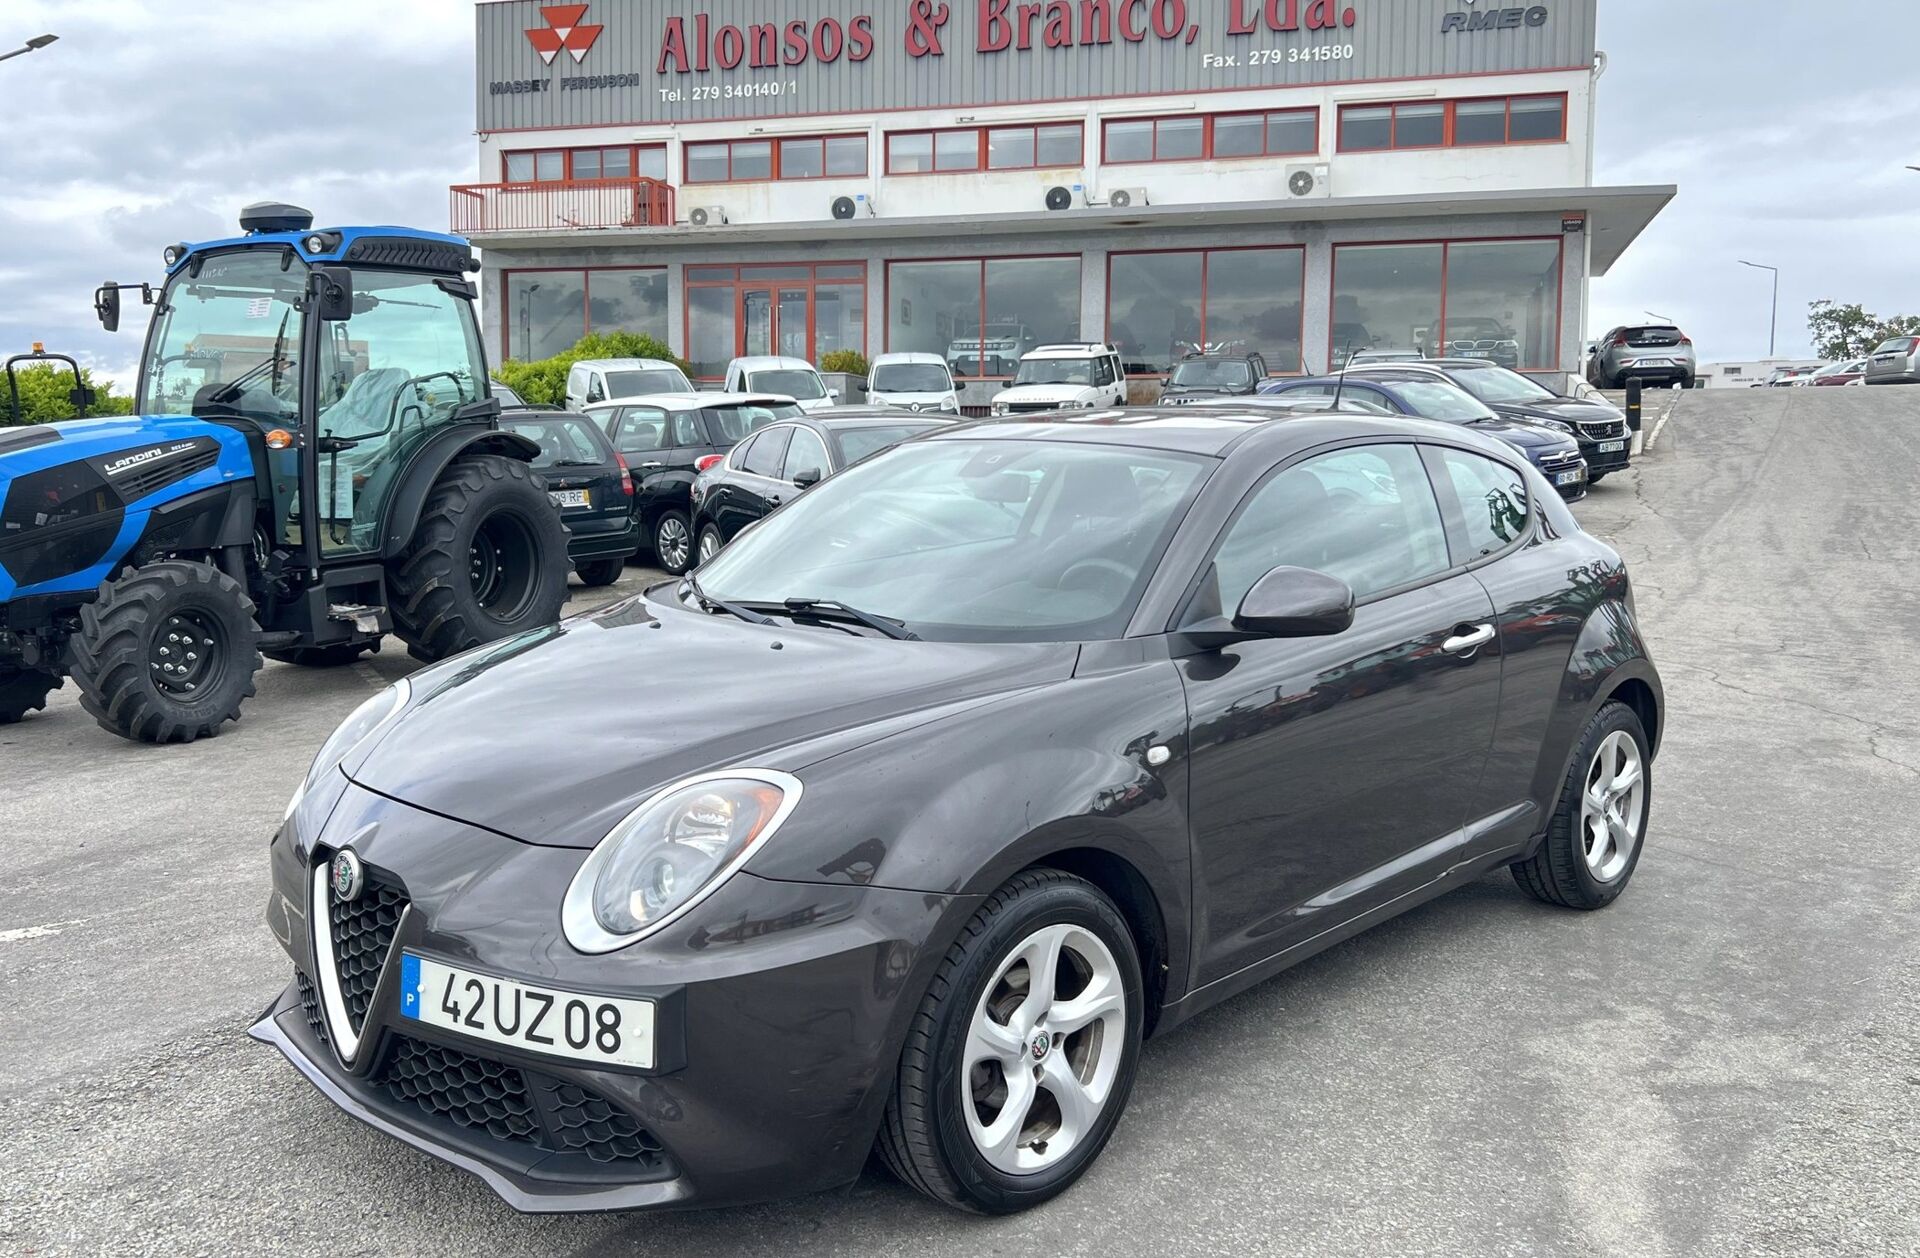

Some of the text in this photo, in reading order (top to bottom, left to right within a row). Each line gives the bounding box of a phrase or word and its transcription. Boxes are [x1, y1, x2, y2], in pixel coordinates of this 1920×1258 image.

[656, 13, 874, 74] Alonsos
[904, 0, 949, 58] &
[976, 0, 1199, 53] Branco,
[1202, 44, 1354, 69] Fax. 279 341580
[489, 73, 640, 95] MASSEY FERGUSON
[659, 80, 798, 102] Tel. 279 340140/1
[104, 448, 162, 471] LANDINI
[406, 993, 415, 1006] P
[441, 973, 621, 1054] 42UZ08
